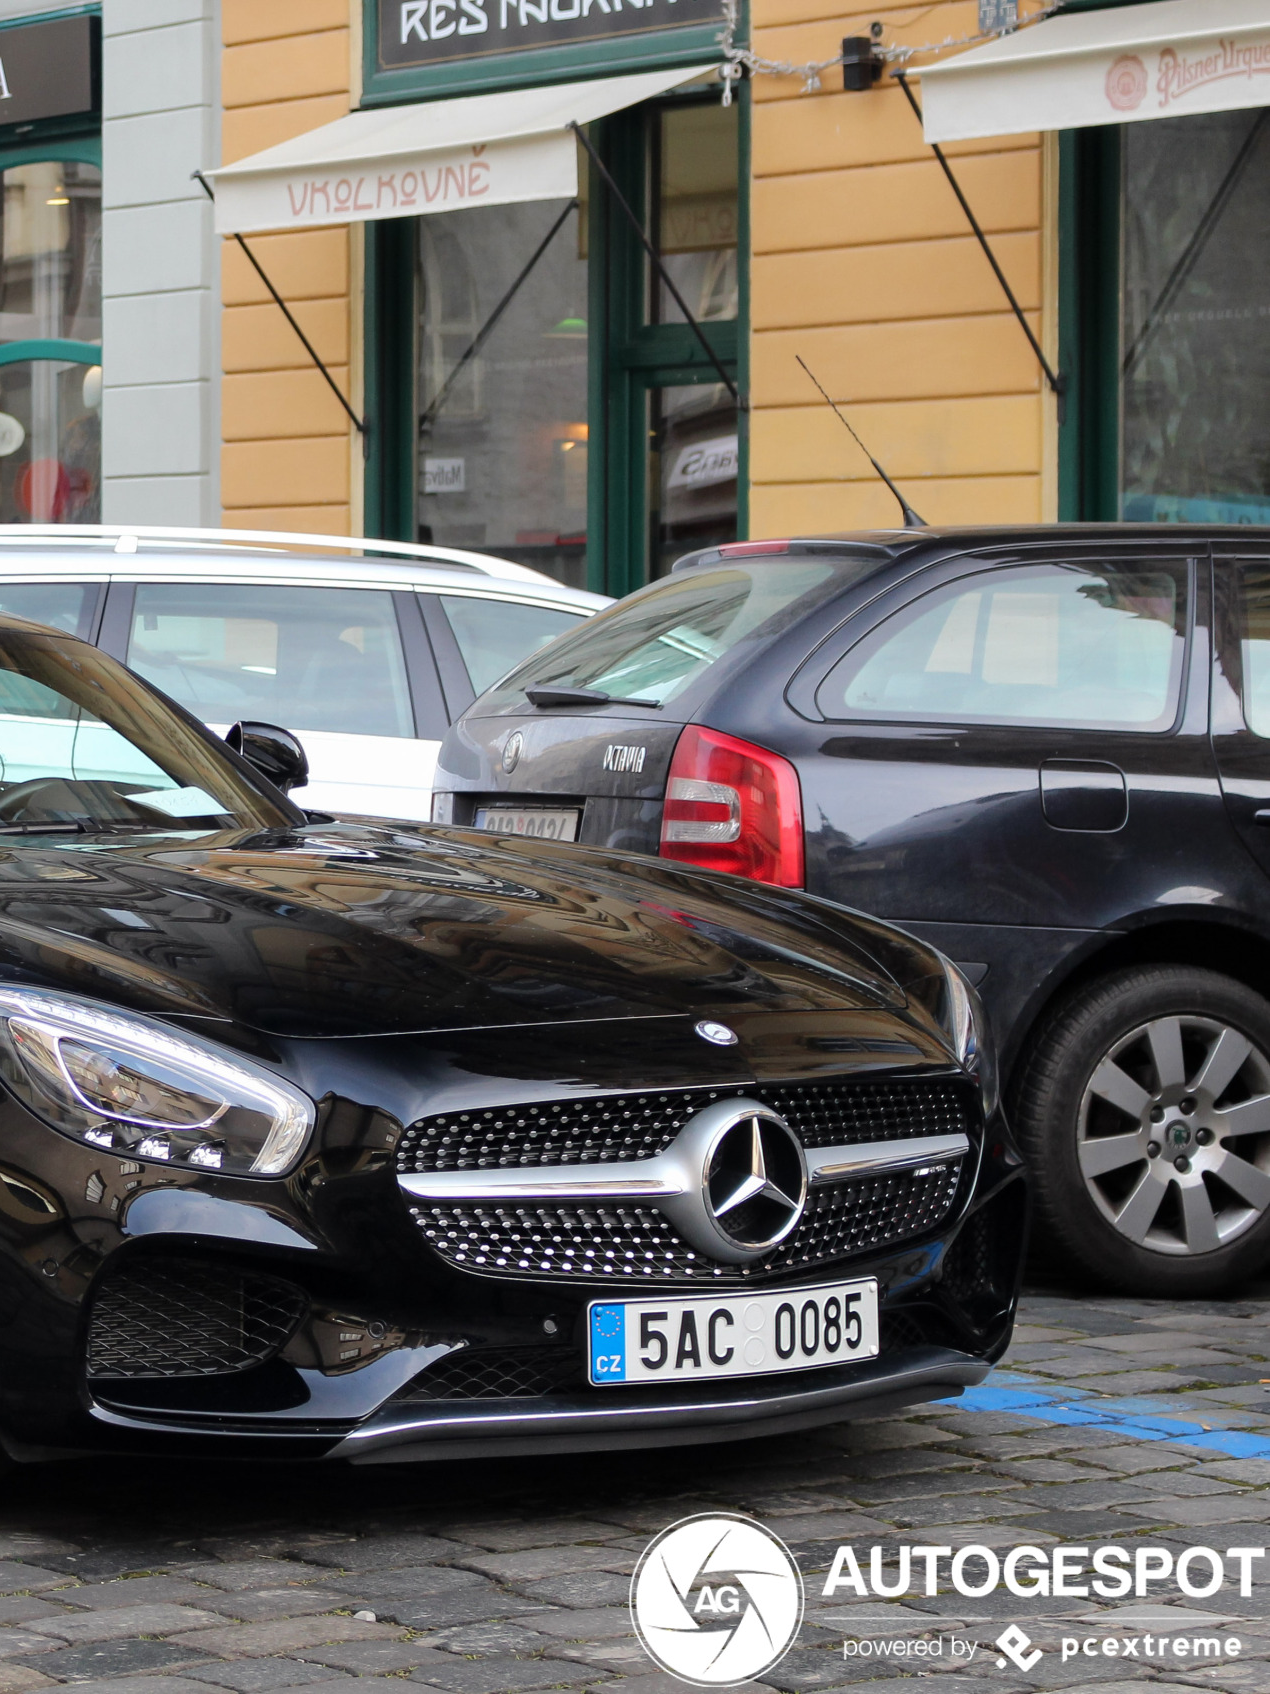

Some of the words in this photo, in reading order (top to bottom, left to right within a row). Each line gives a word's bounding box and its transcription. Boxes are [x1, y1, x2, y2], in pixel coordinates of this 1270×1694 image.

[401, 0, 676, 44] RESTAU
[1157, 47, 1223, 107] Pilsner
[602, 744, 646, 773] OCTAVIA
[639, 1308, 735, 1370] 5AC
[775, 1292, 862, 1360] 0085
[596, 1354, 622, 1373] CZ
